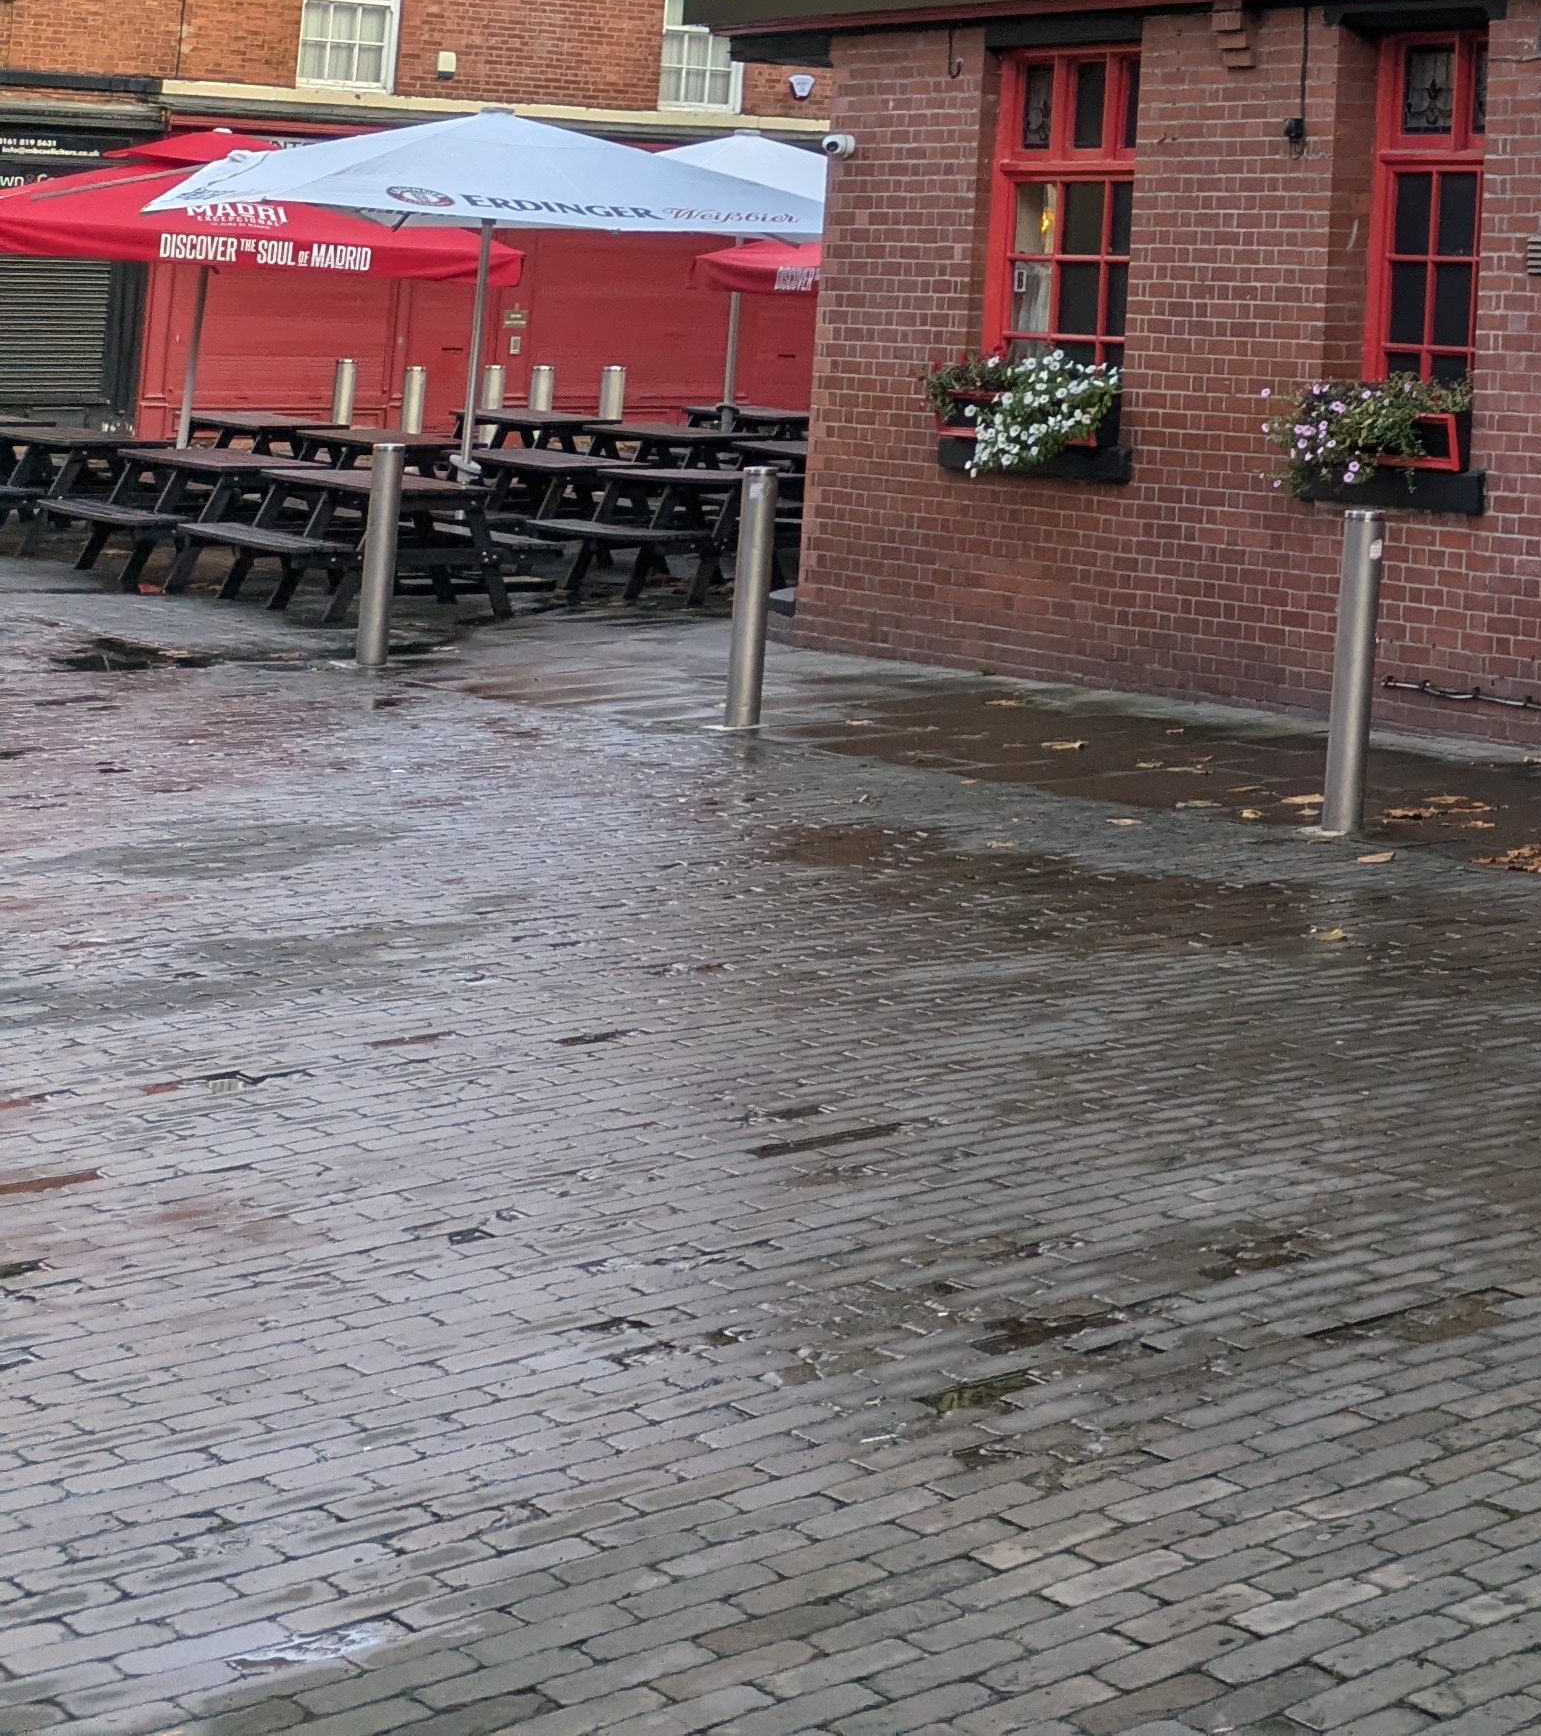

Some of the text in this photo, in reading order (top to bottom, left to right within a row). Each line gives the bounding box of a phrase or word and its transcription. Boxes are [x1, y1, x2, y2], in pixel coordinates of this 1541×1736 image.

[461, 194, 666, 221] ERDINGER
[662, 207, 800, 224] Weißbier
[159, 232, 372, 272] DISCOVER THE SOUL OF MADRID
